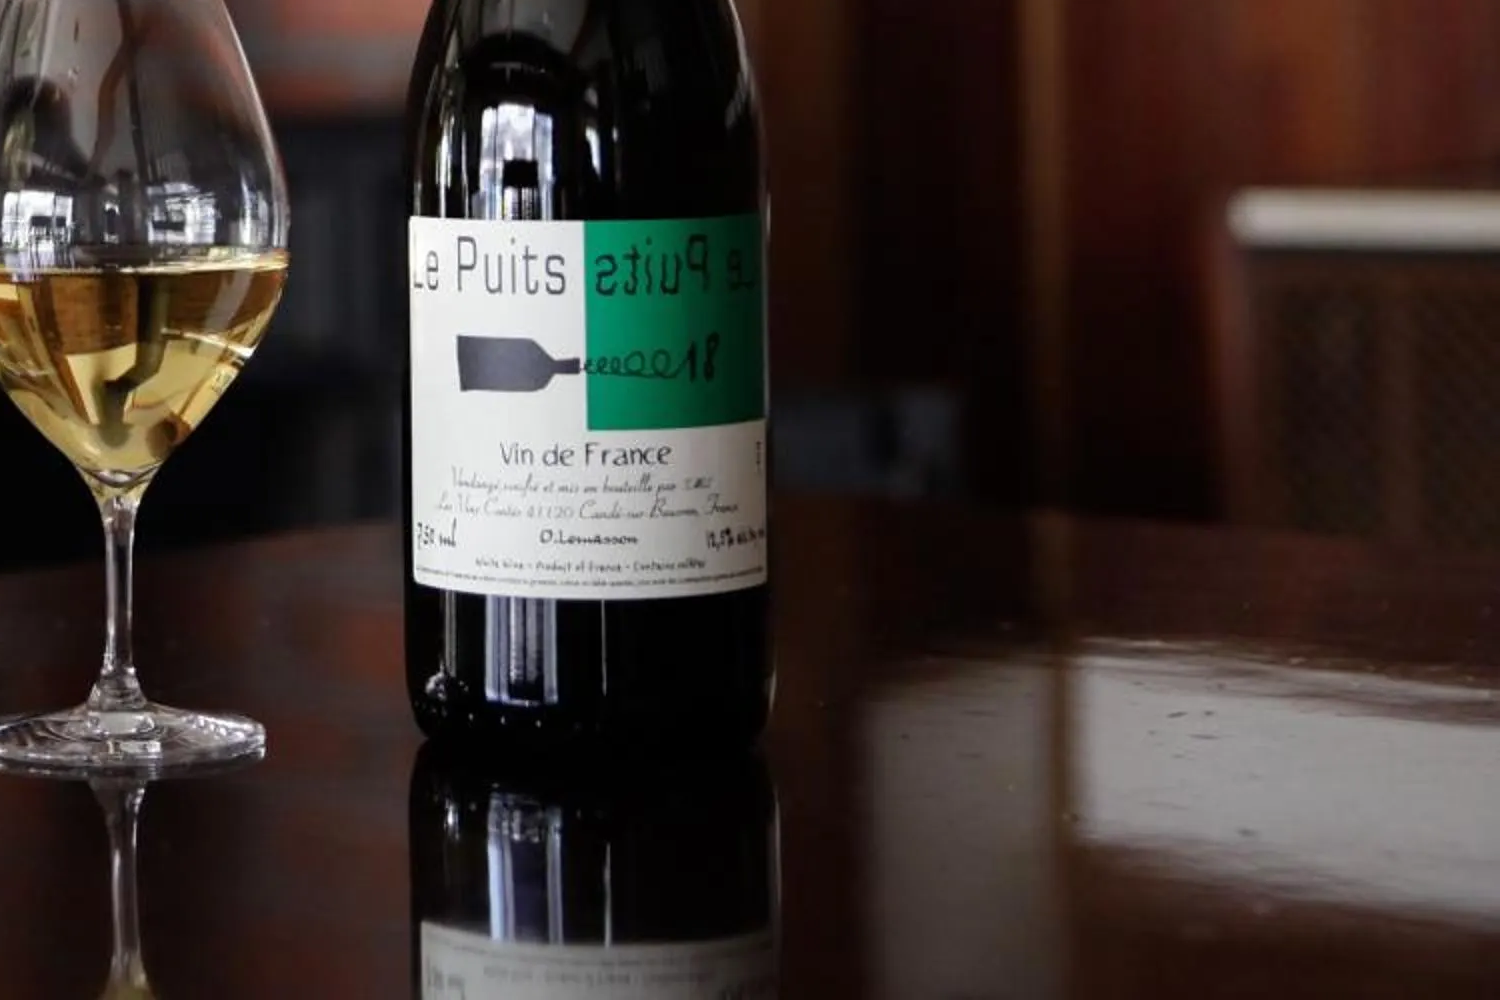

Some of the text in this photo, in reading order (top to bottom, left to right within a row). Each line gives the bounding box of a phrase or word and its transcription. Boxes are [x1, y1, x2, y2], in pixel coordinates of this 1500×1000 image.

[414, 233, 566, 295] Le Puits
[500, 442, 672, 467] Vin de France
[439, 517, 457, 548] ml
